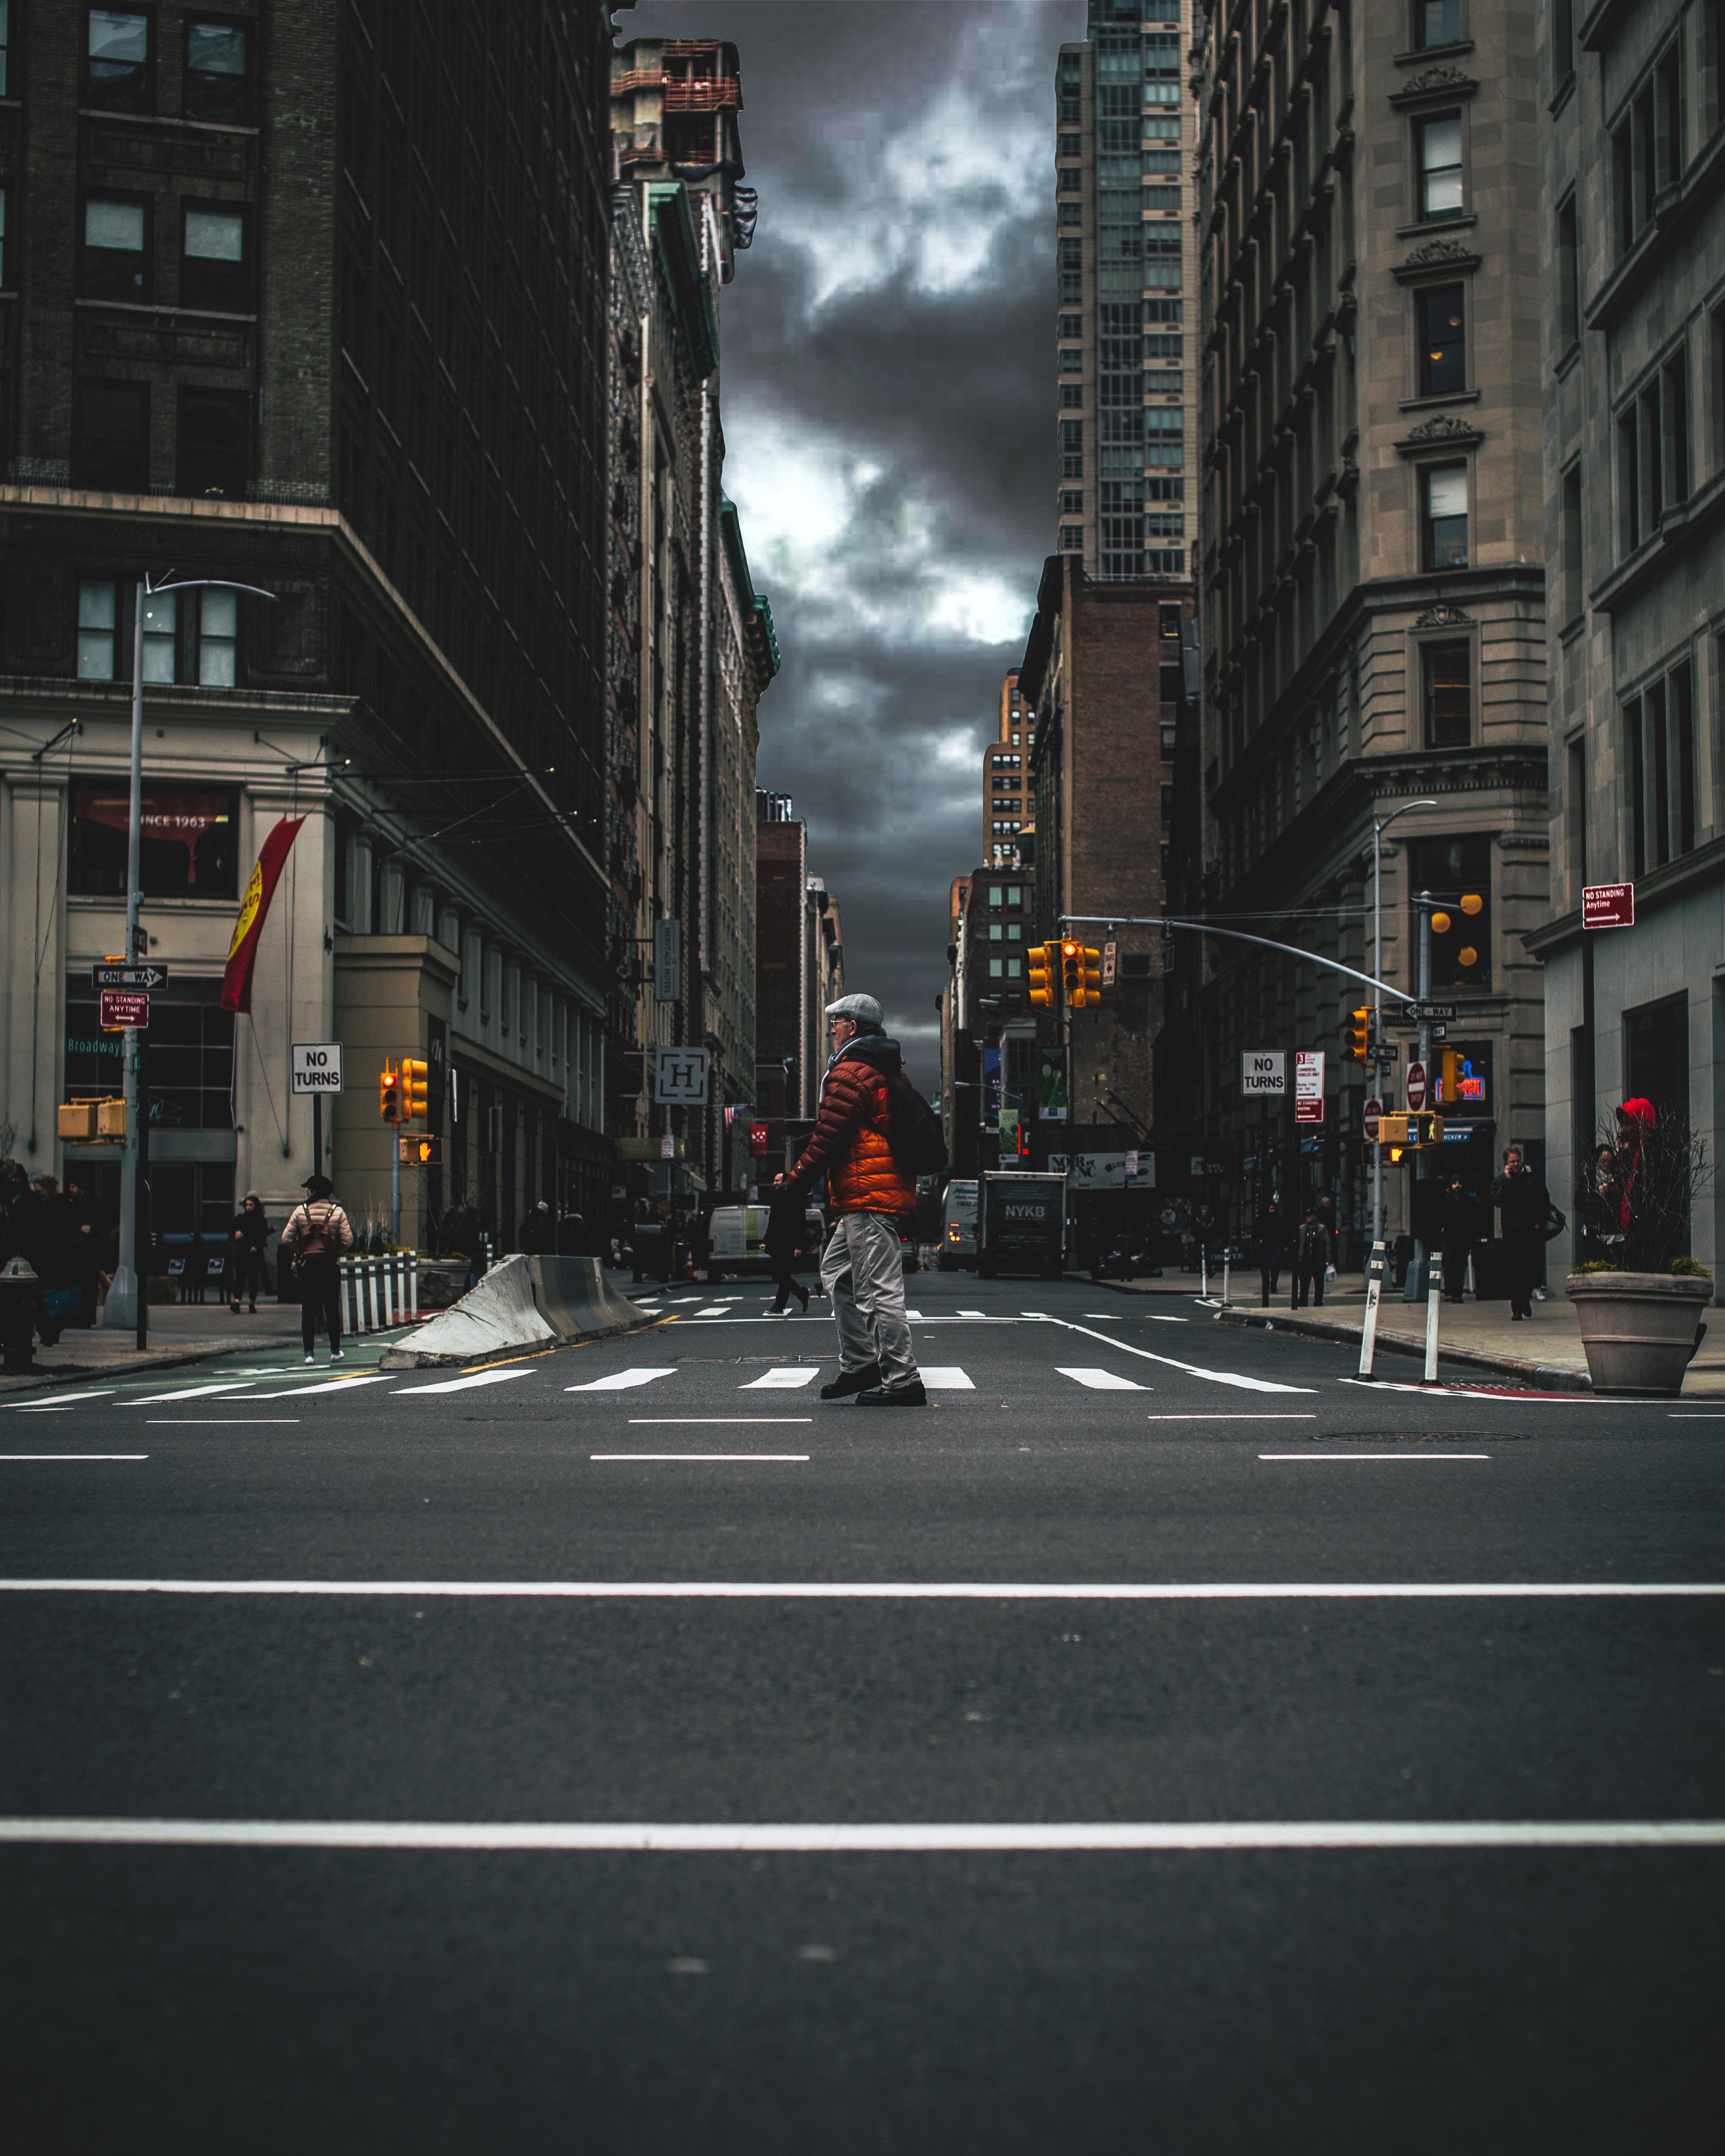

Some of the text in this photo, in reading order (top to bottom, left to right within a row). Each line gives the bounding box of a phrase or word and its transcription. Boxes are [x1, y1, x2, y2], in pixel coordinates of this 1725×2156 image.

[141, 815, 206, 829] INCE 1963
[1586, 889, 1624, 900] NO STANDING
[1587, 900, 1611, 910] Anytime
[103, 971, 156, 983] ONE WAY
[104, 996, 145, 1005] NO STANDING
[109, 1005, 141, 1014] ANYTIME
[1410, 1006, 1449, 1016] ONE WAY
[68, 1038, 120, 1057] Broadway
[306, 1051, 327, 1067] NO
[1254, 1058, 1273, 1071] NO
[1299, 1054, 1304, 1064] 3
[295, 1071, 339, 1086] TURNS
[670, 1064, 695, 1088] H
[1244, 1076, 1283, 1088] TURNS
[1006, 1205, 1045, 1217] NYKB
